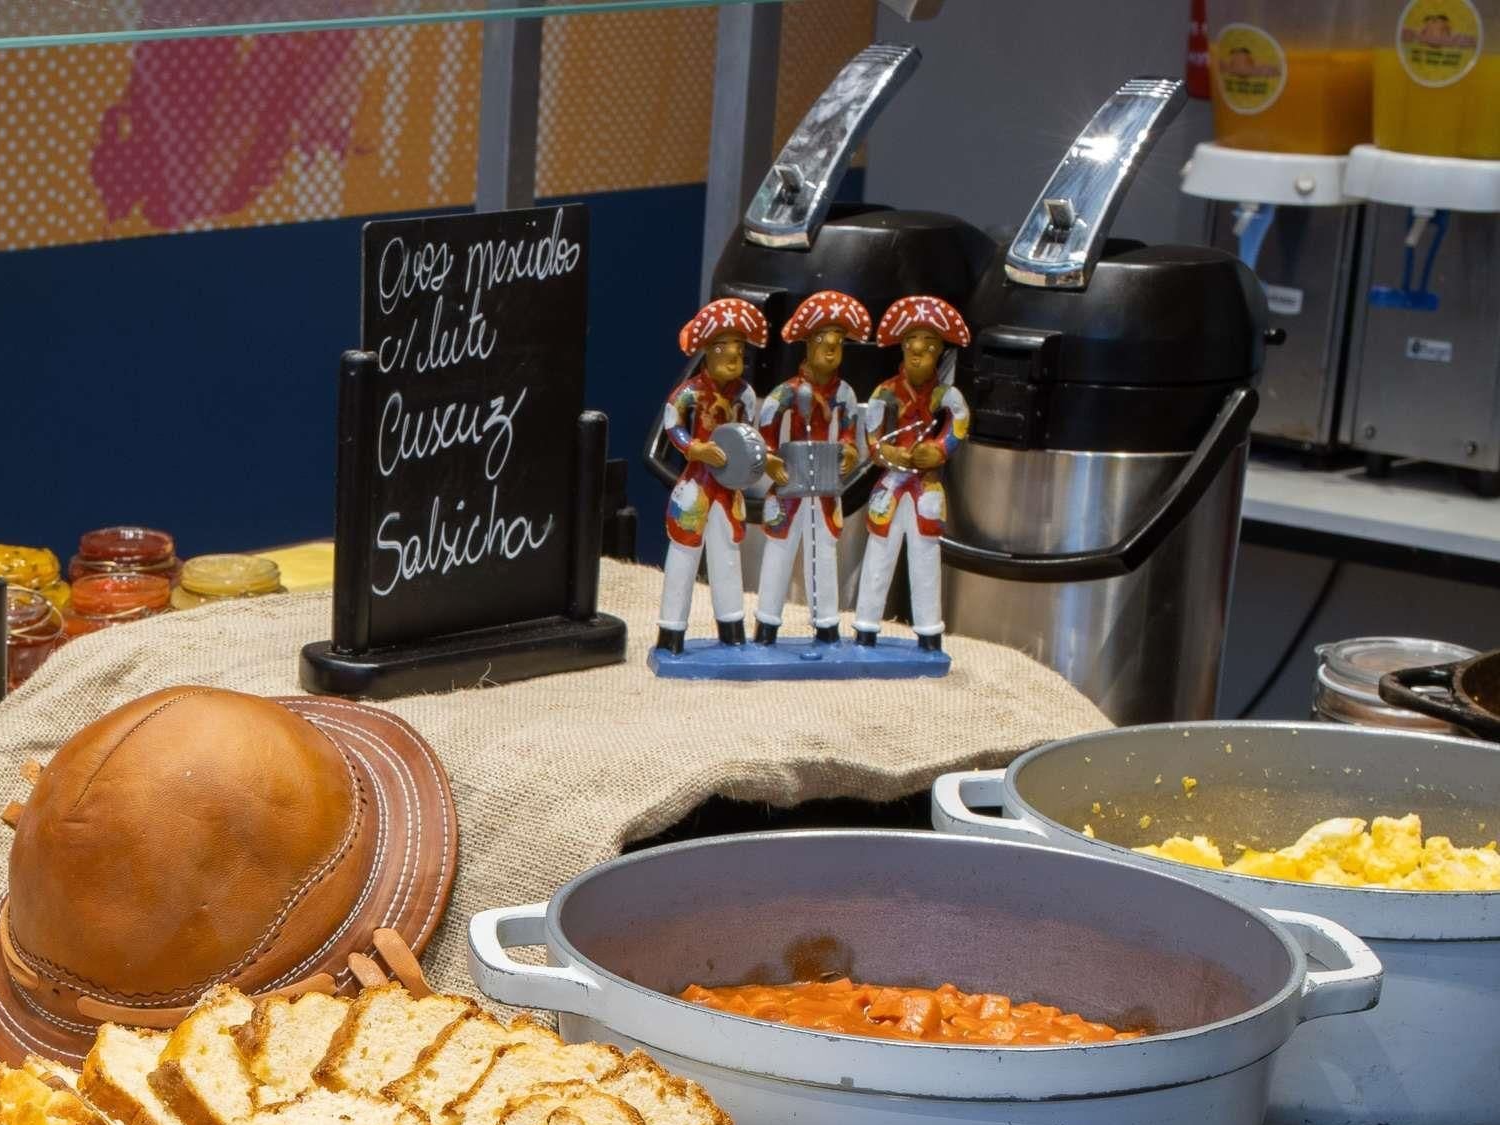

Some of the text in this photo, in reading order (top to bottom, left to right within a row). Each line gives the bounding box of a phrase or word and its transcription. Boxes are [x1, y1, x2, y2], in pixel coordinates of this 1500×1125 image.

[379, 206, 581, 314] Ovos mexidos
[379, 386, 527, 480] Cuscuz
[371, 484, 553, 596] Salsicha
